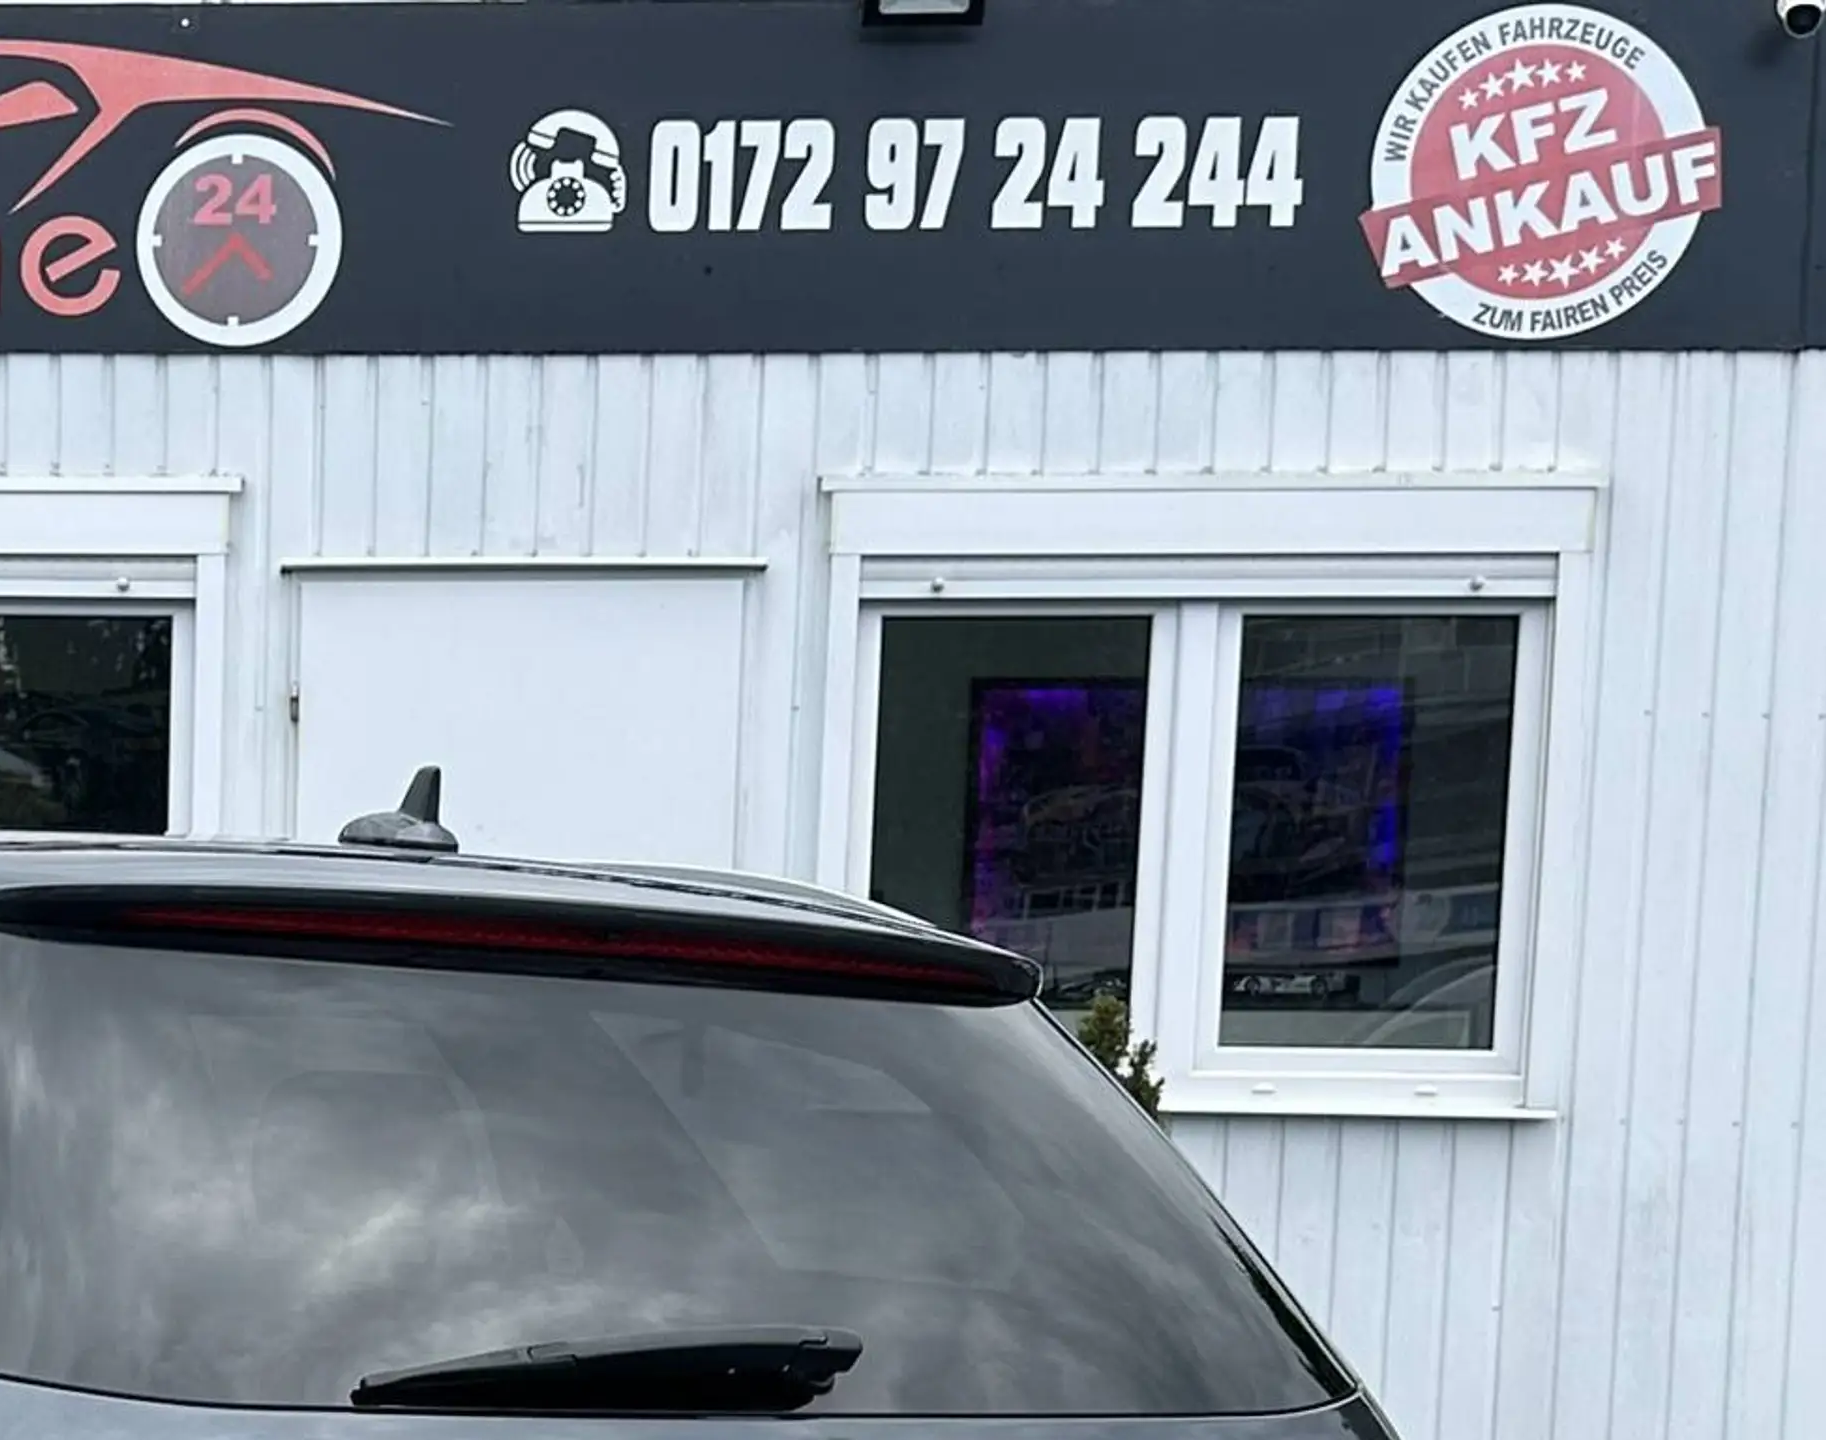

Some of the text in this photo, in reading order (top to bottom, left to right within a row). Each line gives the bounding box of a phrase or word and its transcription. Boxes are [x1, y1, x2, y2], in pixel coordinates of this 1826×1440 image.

[1383, 16, 1646, 162] WIR KAUFEN FAHRZEUGE
[1449, 87, 1618, 182] KFZ
[193, 173, 277, 226] 24
[647, 115, 1304, 232] 0172 97 24 244
[1380, 142, 1718, 278] ANKAUF
[1472, 249, 1668, 332] ZUM FAIREN PREIS
